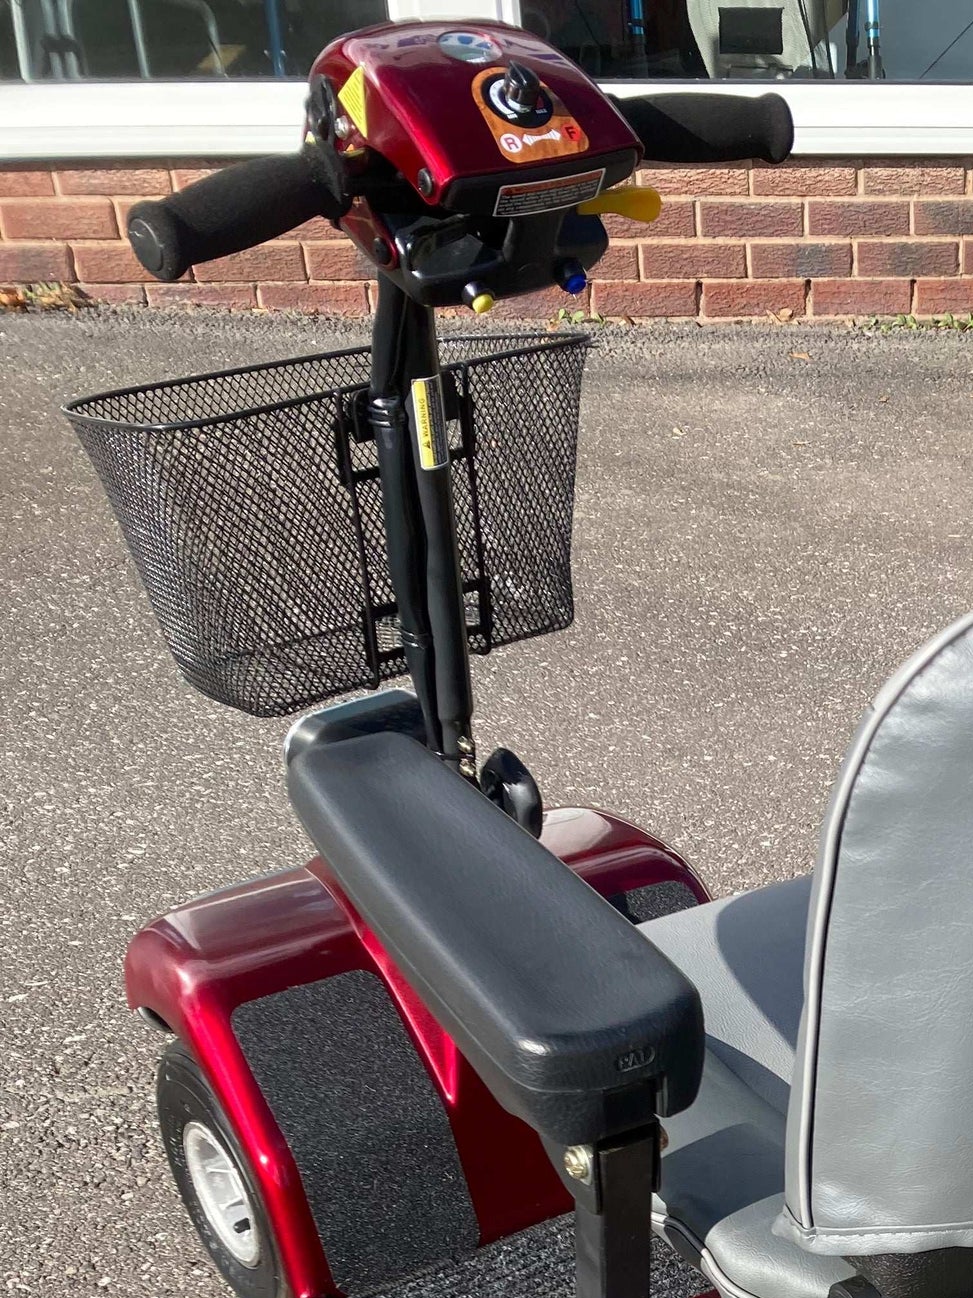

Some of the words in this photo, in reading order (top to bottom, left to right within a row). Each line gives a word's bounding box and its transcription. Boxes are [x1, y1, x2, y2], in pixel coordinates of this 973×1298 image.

[504, 137, 519, 151] R
[565, 126, 576, 140] F
[420, 398, 431, 438] WARNING
